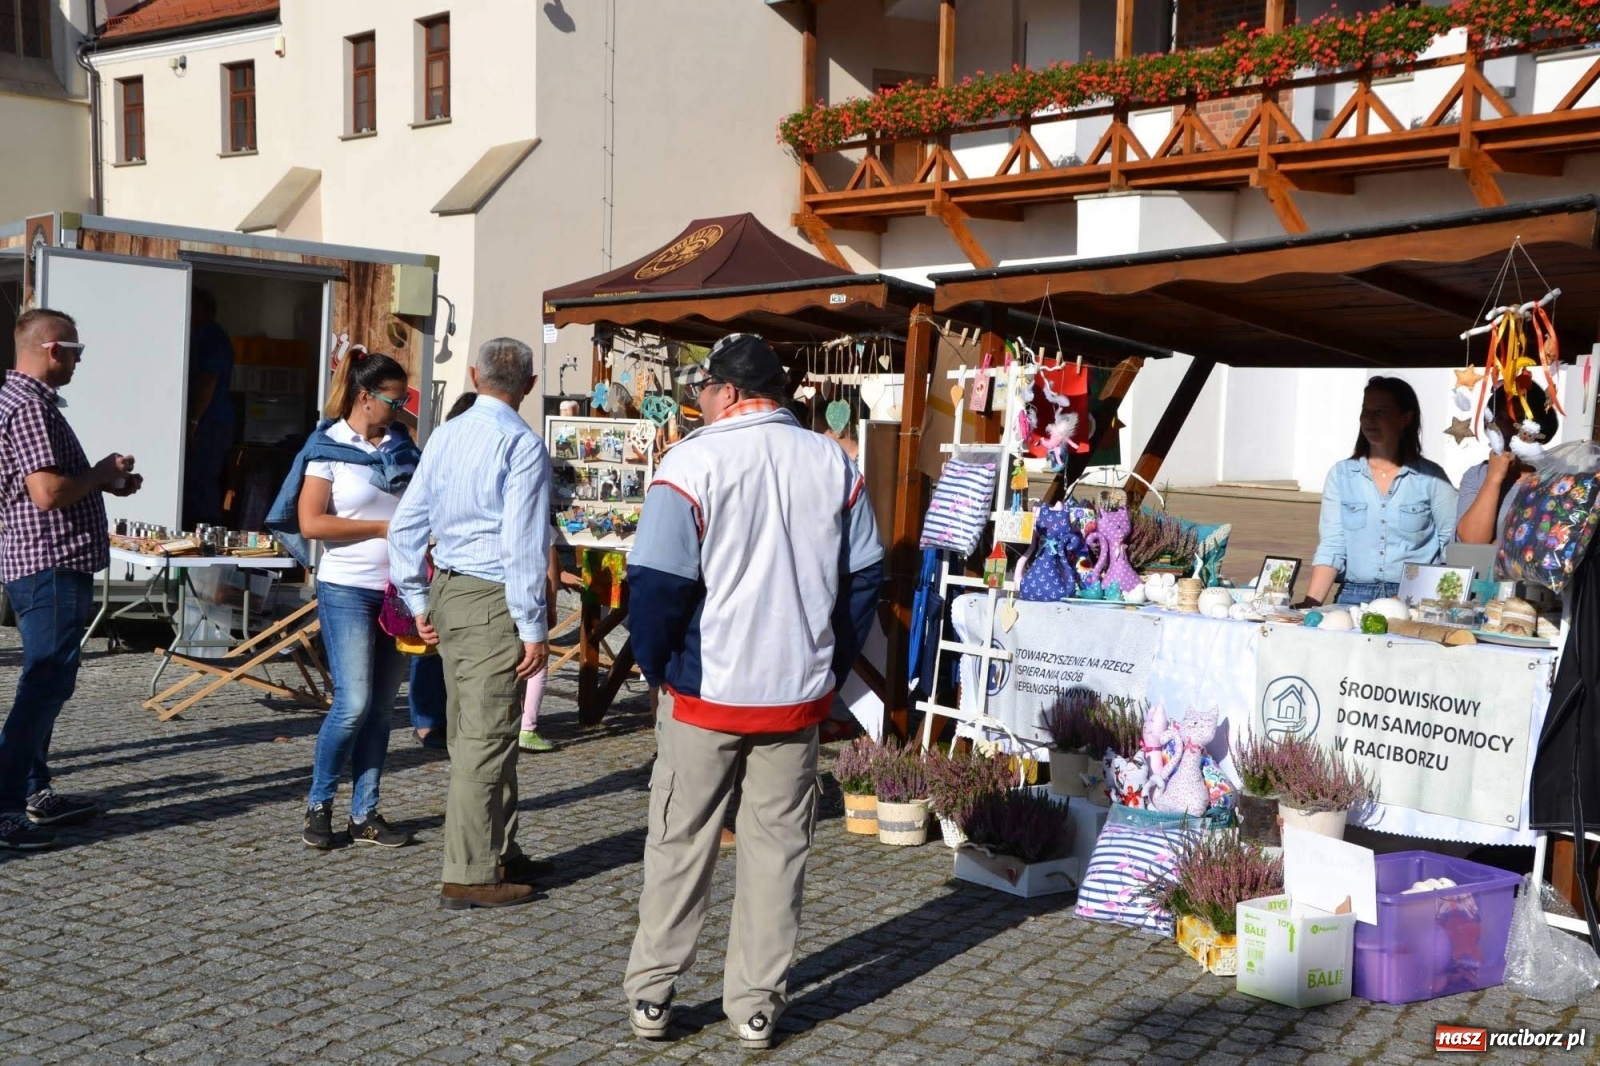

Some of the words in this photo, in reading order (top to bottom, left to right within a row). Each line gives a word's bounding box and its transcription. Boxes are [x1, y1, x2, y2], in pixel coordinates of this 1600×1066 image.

[1015, 664, 1060, 680] SPIERANIA
[1060, 669, 1084, 682] OSÓB
[1087, 657, 1100, 668] NA
[1101, 659, 1135, 674] RZECZ
[1339, 676, 1481, 717] ŚRODOWISKOWY
[1337, 708, 1378, 729] DOM
[1381, 715, 1514, 753] SAMOPOMOCY
[1334, 735, 1349, 752] W
[1353, 739, 1449, 771] RACIBORZU
[1278, 919, 1290, 928] TOP
[1307, 970, 1339, 989] BALI
